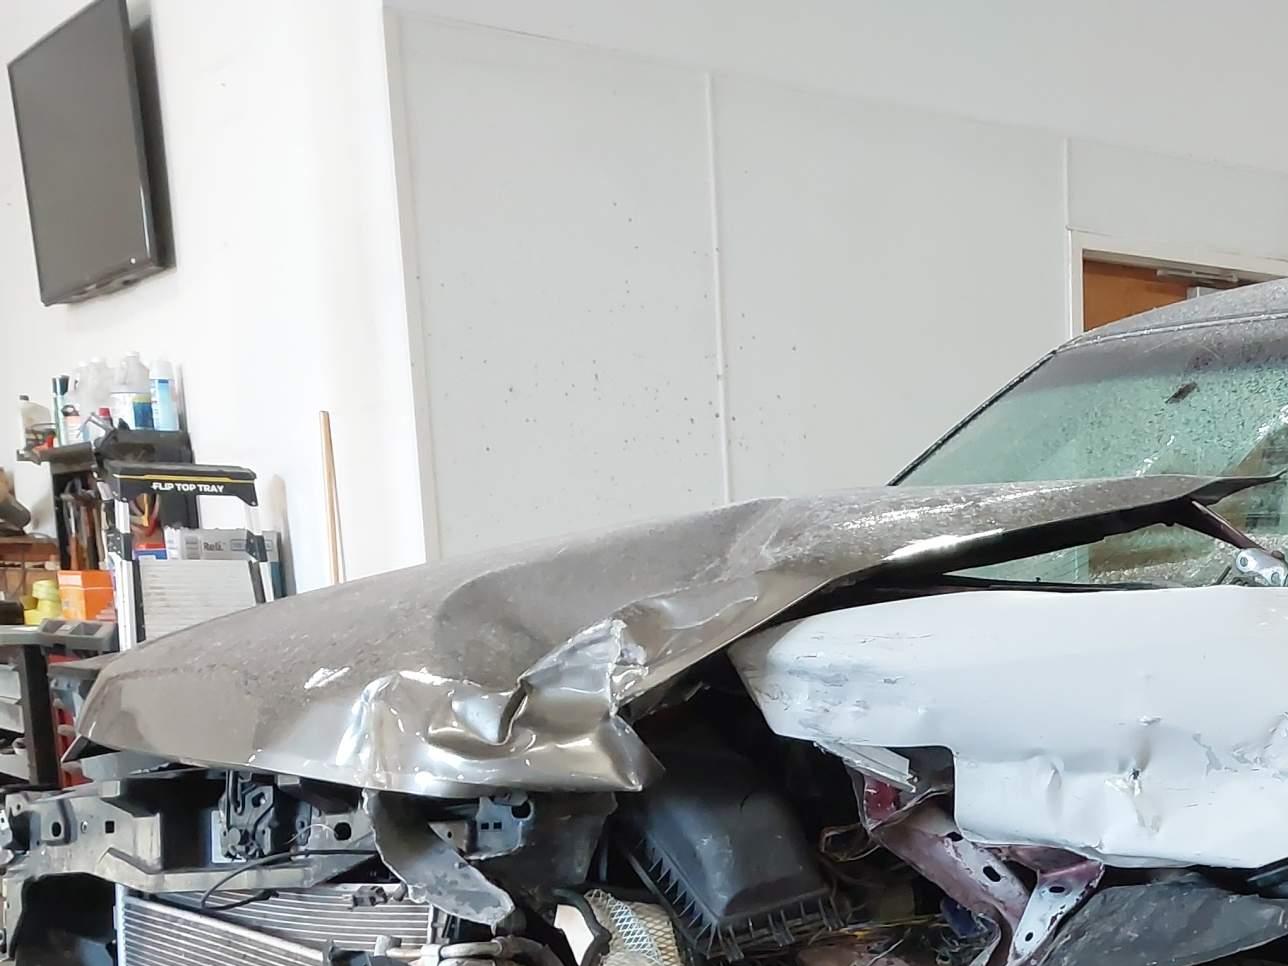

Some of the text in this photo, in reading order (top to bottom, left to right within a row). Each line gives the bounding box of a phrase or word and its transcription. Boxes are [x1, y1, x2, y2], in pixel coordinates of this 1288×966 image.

[151, 481, 225, 493] FLIP TOP TRAY
